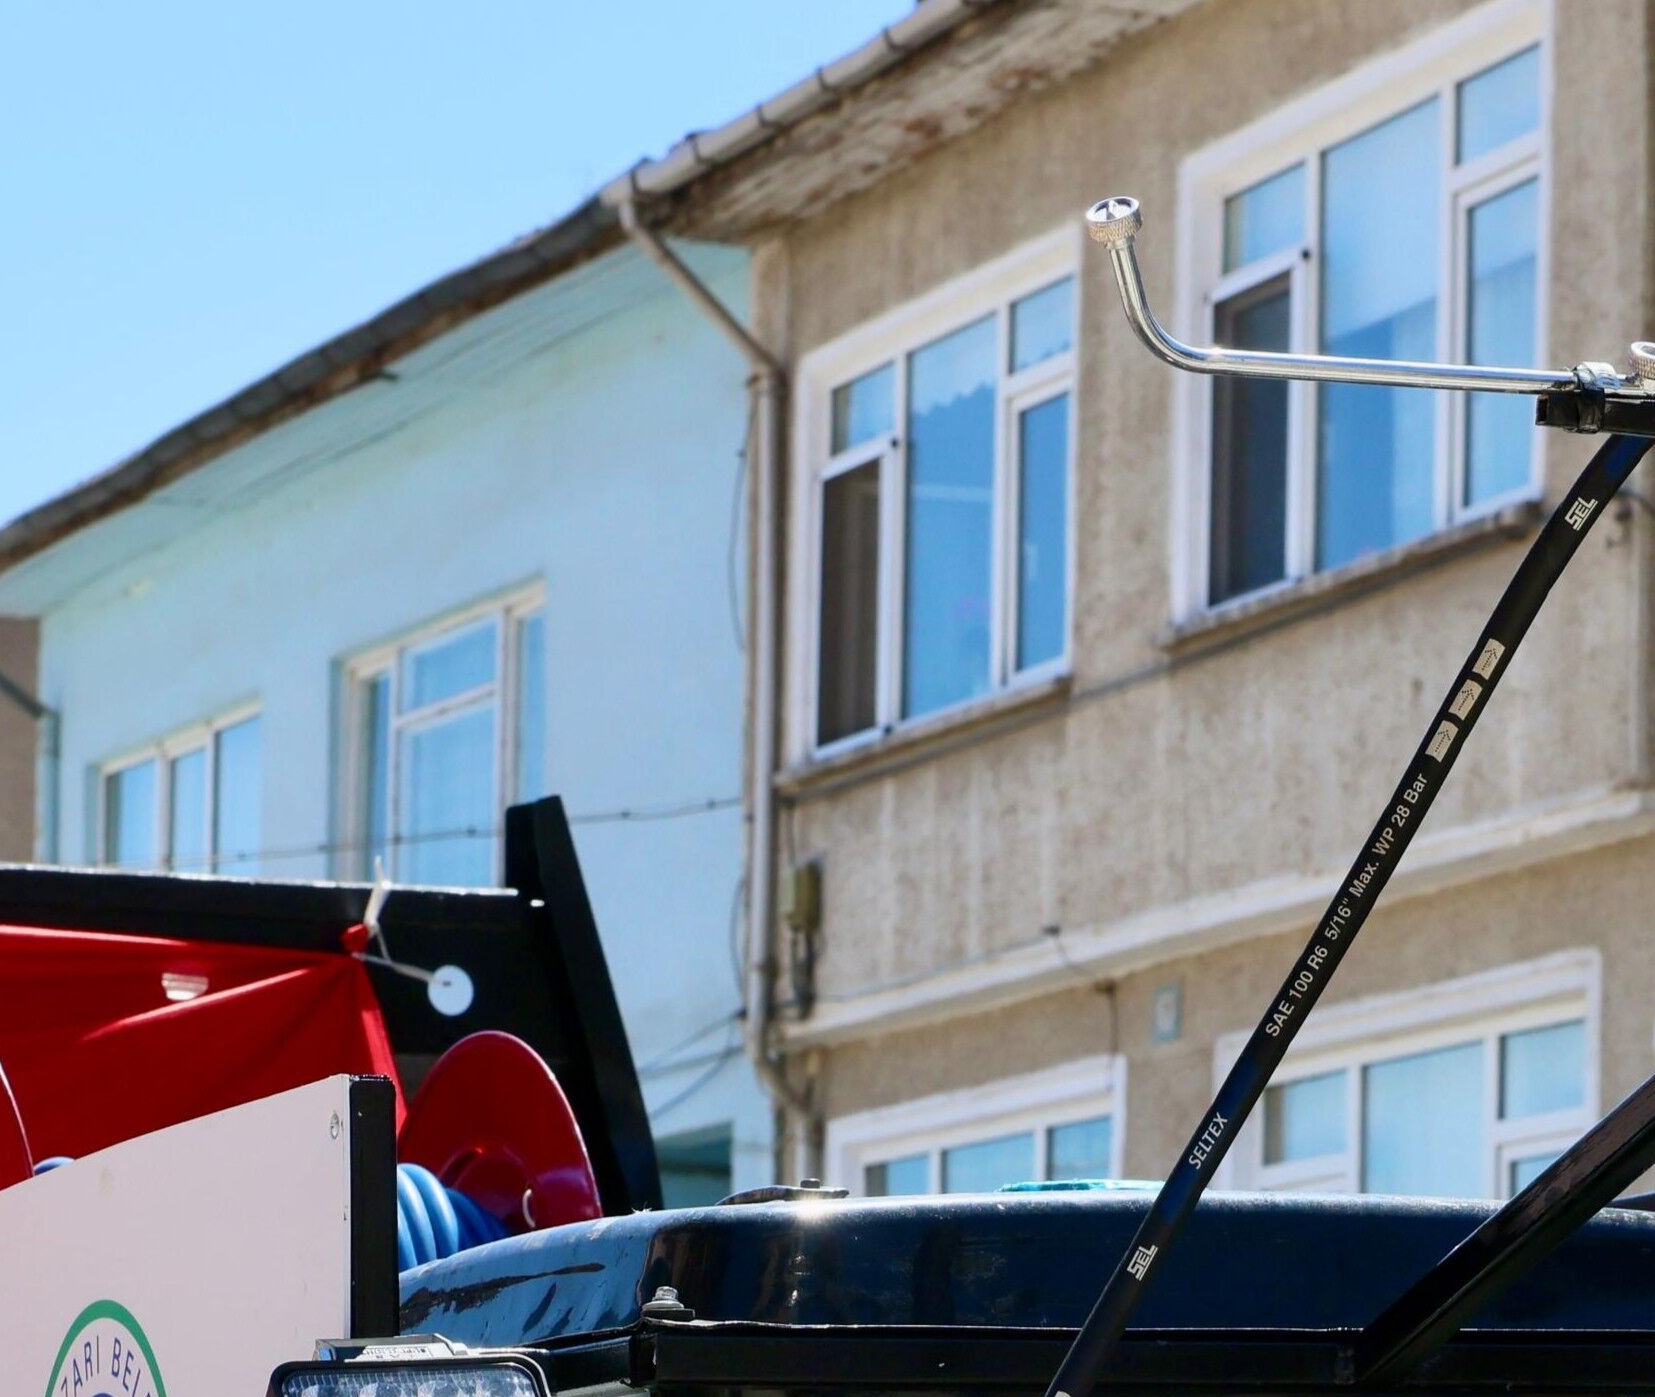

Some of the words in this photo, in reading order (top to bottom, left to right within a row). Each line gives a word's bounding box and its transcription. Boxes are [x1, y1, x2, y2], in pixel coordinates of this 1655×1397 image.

[1564, 497, 1598, 531] SEL
[1126, 1244, 1158, 1281] SEL
[1188, 1111, 1228, 1170] SELTEX
[1265, 1000, 1295, 1037] SAE
[1288, 970, 1314, 998] 100
[1307, 945, 1329, 970] R6
[1324, 898, 1352, 940] 5/16"
[1348, 861, 1380, 898] Max.
[1371, 827, 1395, 856] WP
[1391, 804, 1411, 828] 28
[1403, 772, 1428, 804] Bar
